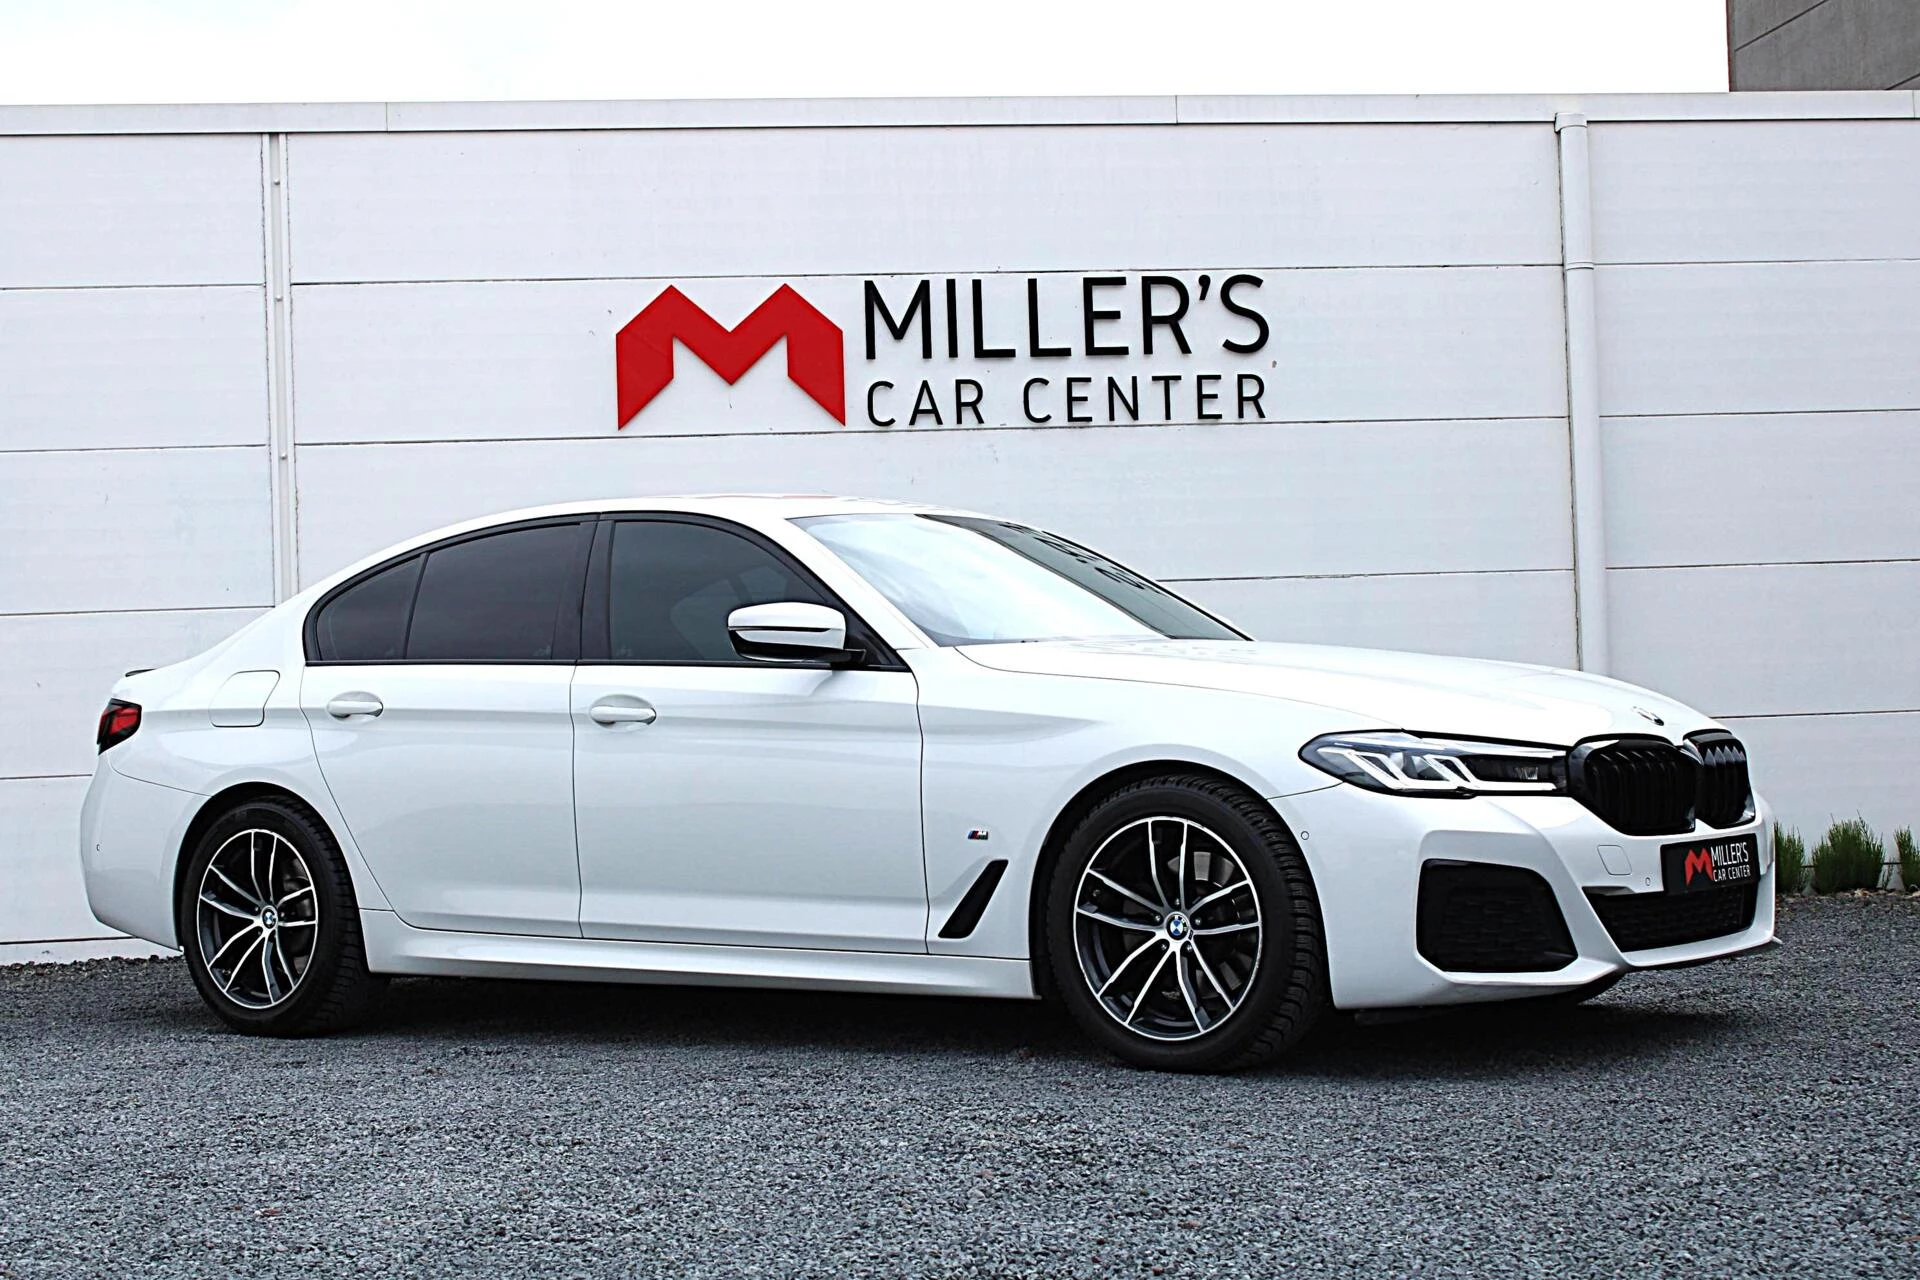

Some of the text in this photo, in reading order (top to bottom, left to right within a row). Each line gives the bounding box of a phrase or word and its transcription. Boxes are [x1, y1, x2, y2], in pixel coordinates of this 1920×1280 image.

[863, 273, 1271, 362] MILLER'S
[866, 373, 1268, 427] CAR CENTER
[1710, 842, 1749, 867] MILLER'S
[1713, 865, 1751, 882] CAR CENTER
